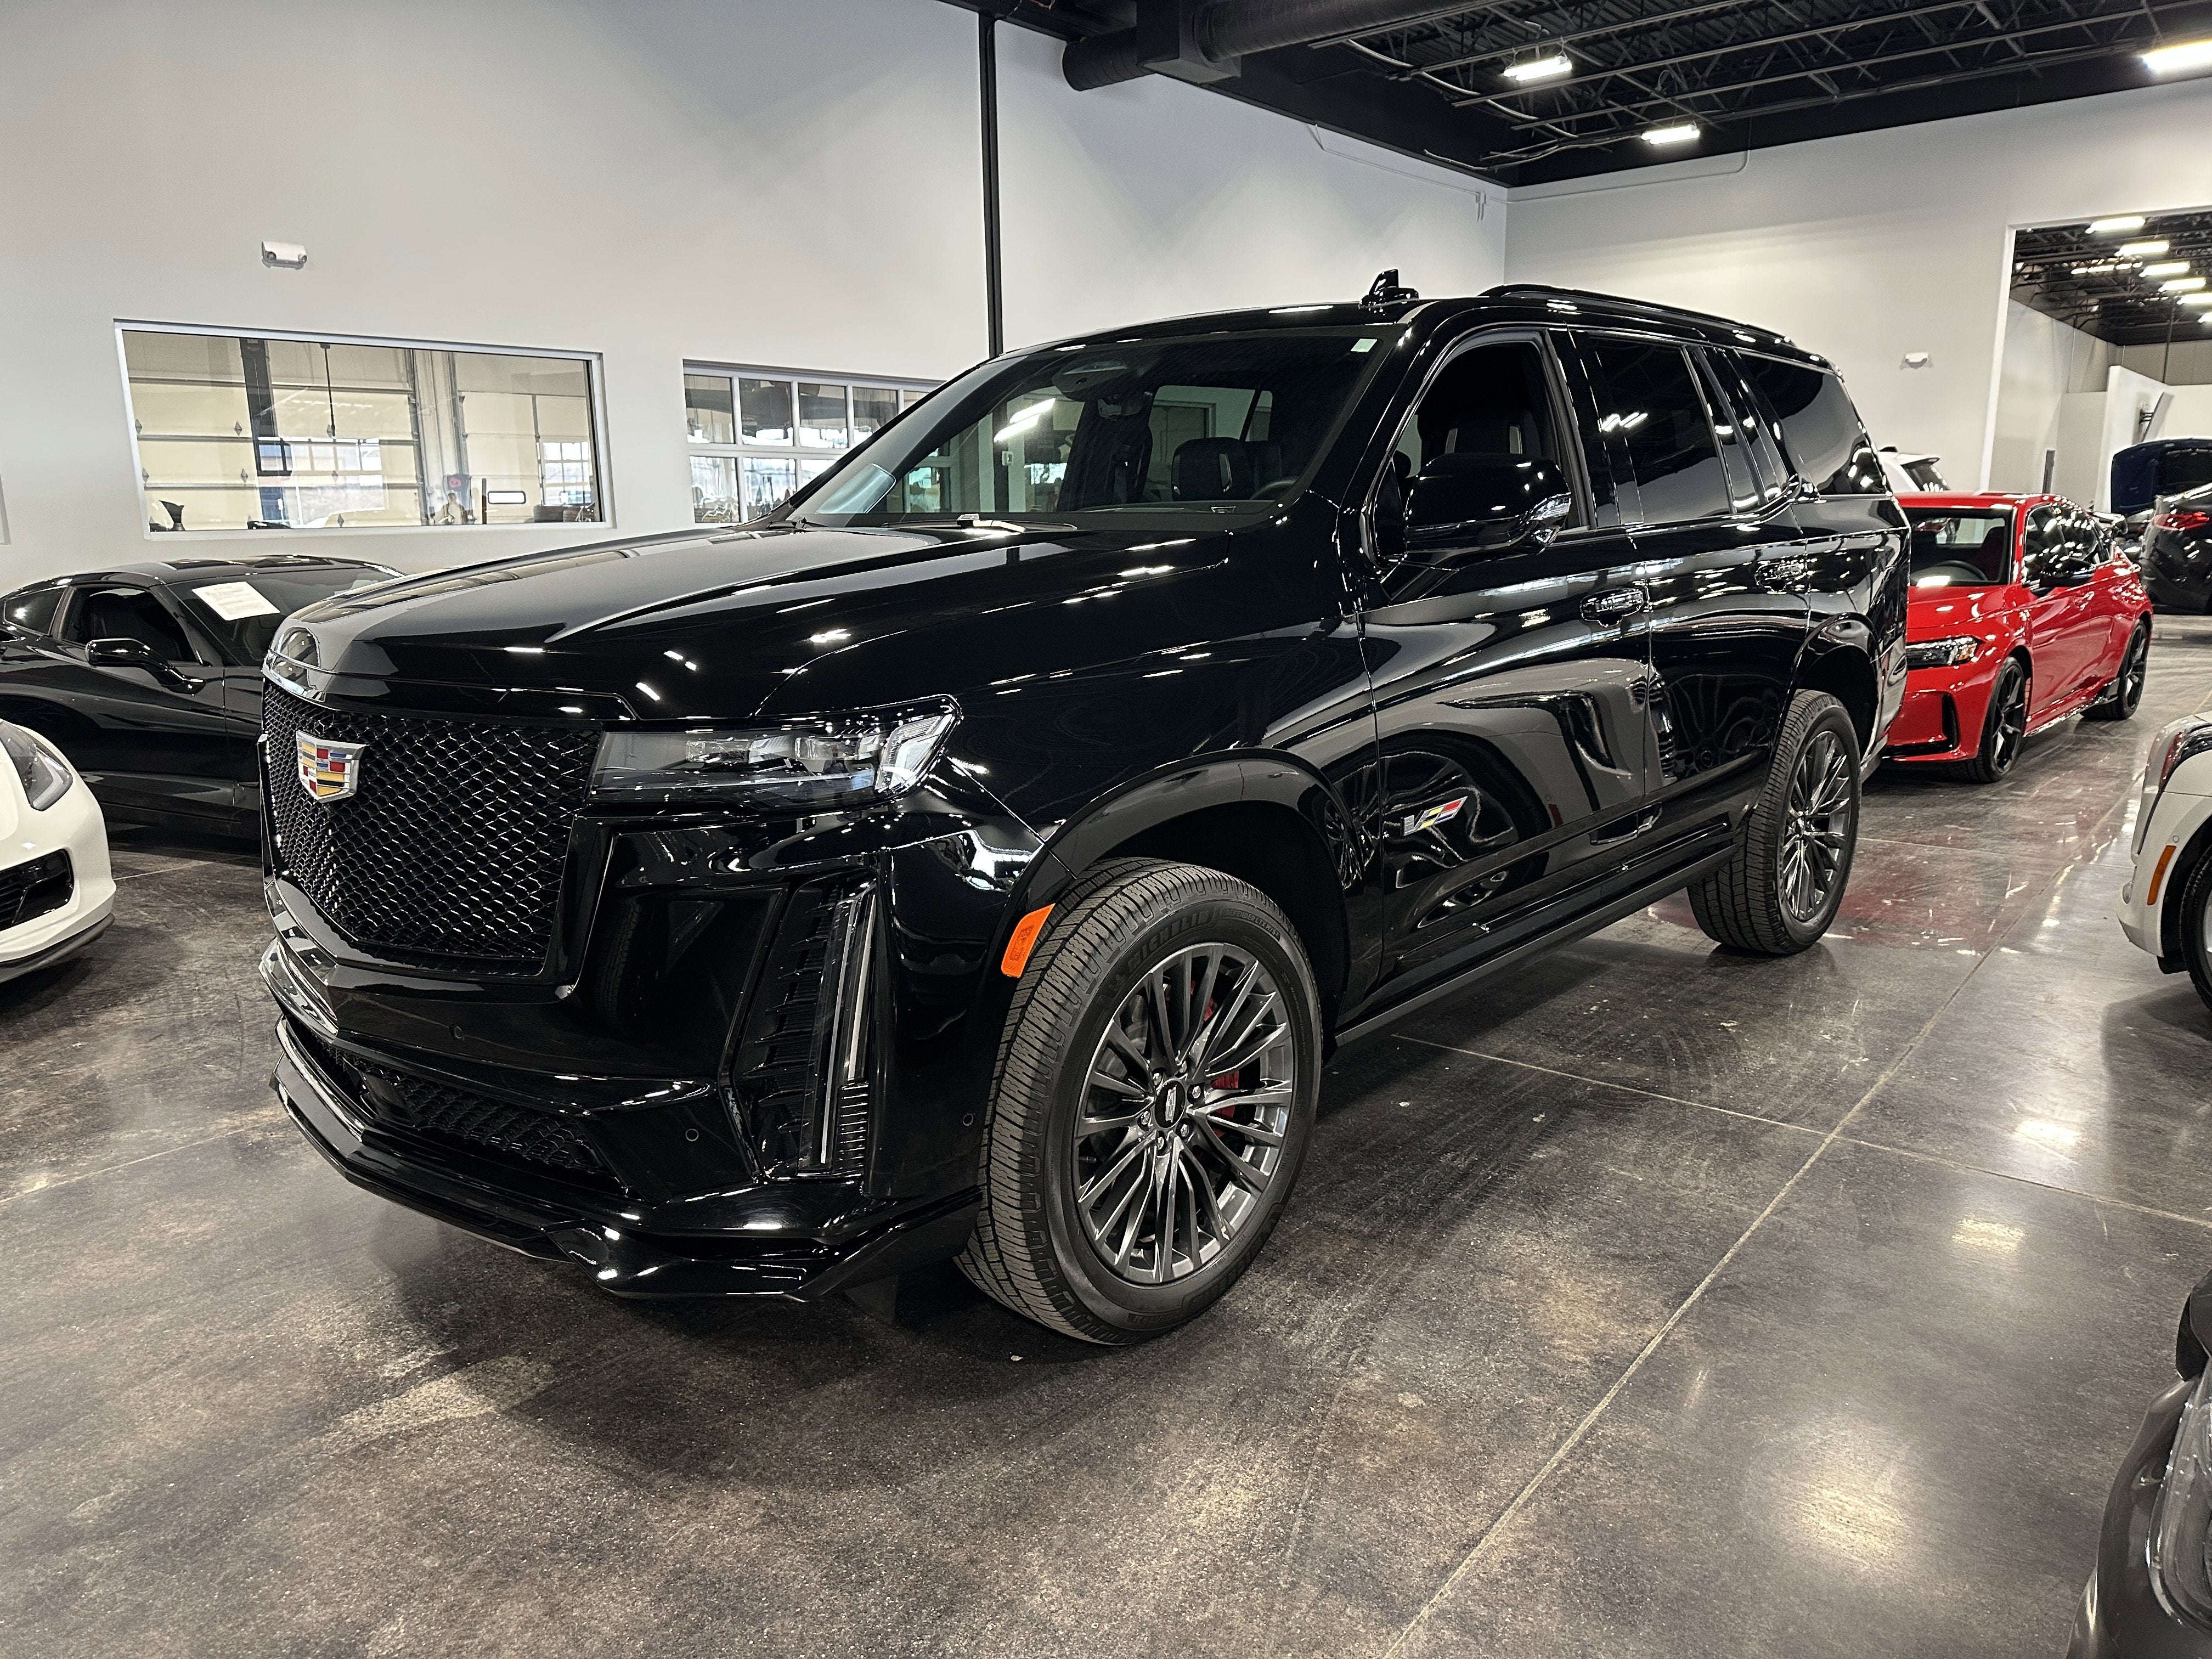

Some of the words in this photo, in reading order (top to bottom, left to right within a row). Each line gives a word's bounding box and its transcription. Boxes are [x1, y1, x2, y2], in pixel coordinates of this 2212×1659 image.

[1224, 910, 1256, 922] DEFENDER
[1255, 917, 1267, 928] LTX
[1127, 910, 1210, 974] MICHELIN
